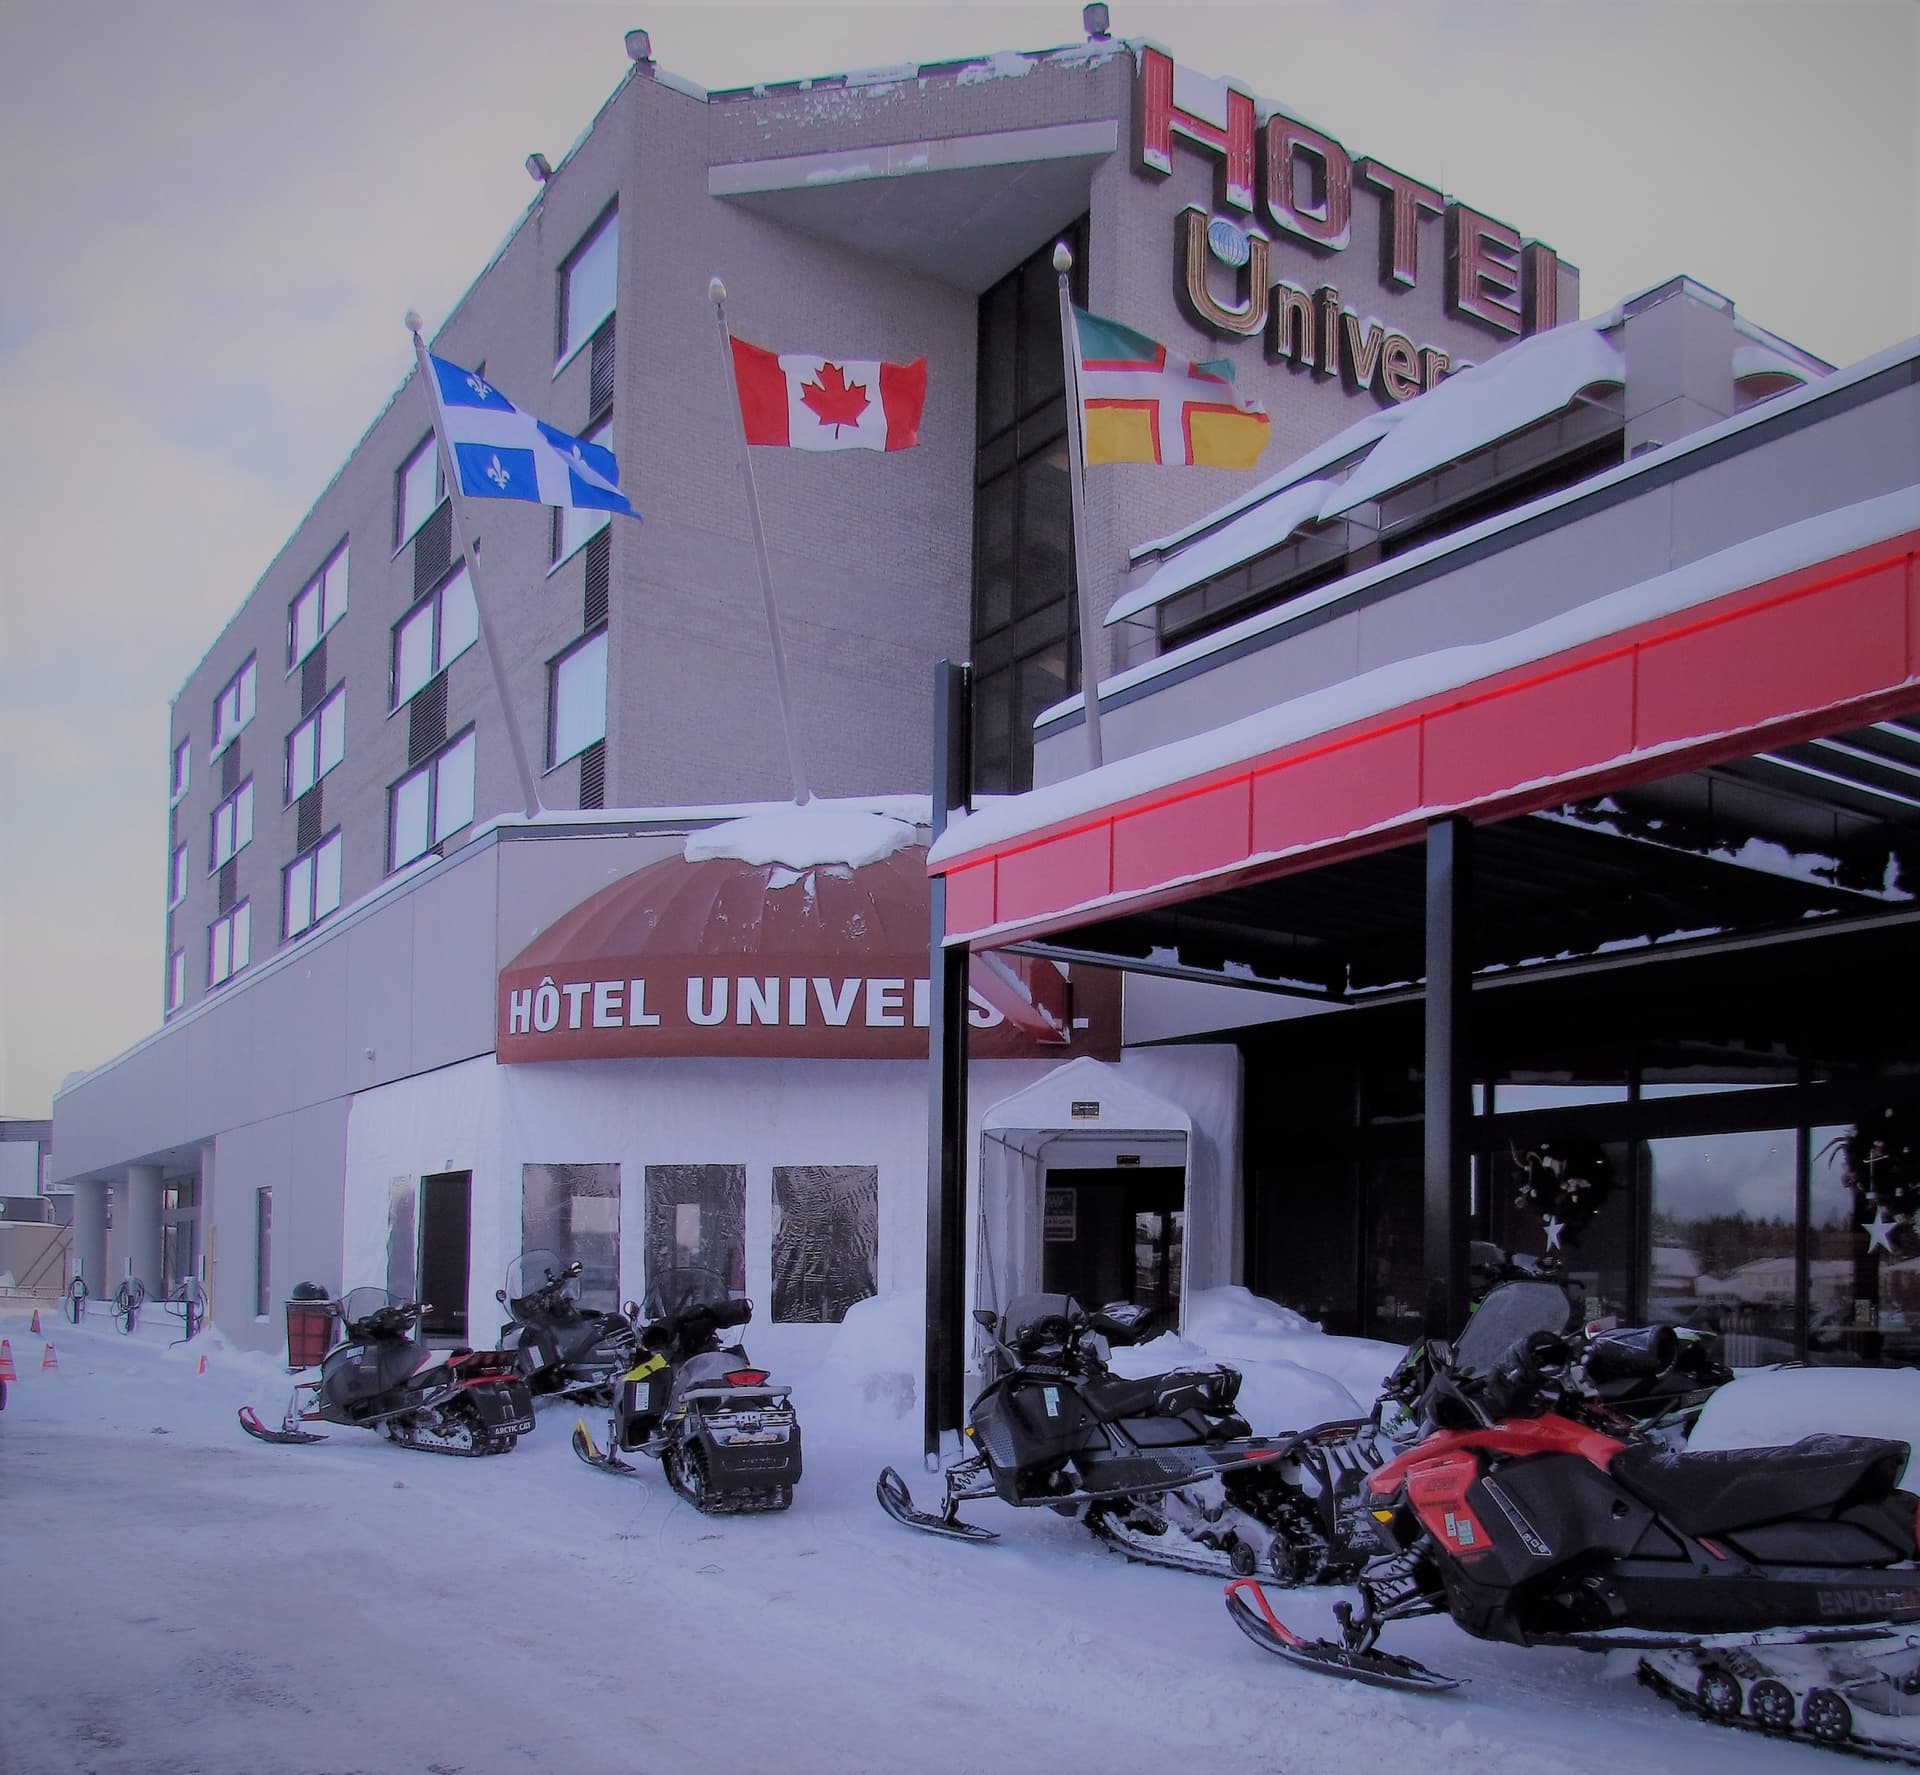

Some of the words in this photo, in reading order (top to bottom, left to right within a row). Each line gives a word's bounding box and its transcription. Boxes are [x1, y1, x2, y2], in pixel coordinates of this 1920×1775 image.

[1182, 207, 1454, 402] Univer
[509, 976, 661, 1035] HÔTEL
[686, 976, 1089, 1029] UNIVE
[495, 1424, 518, 1435] ARCTIC
[519, 1421, 531, 1431] CAT
[1817, 1587, 1898, 1616] ENDU
